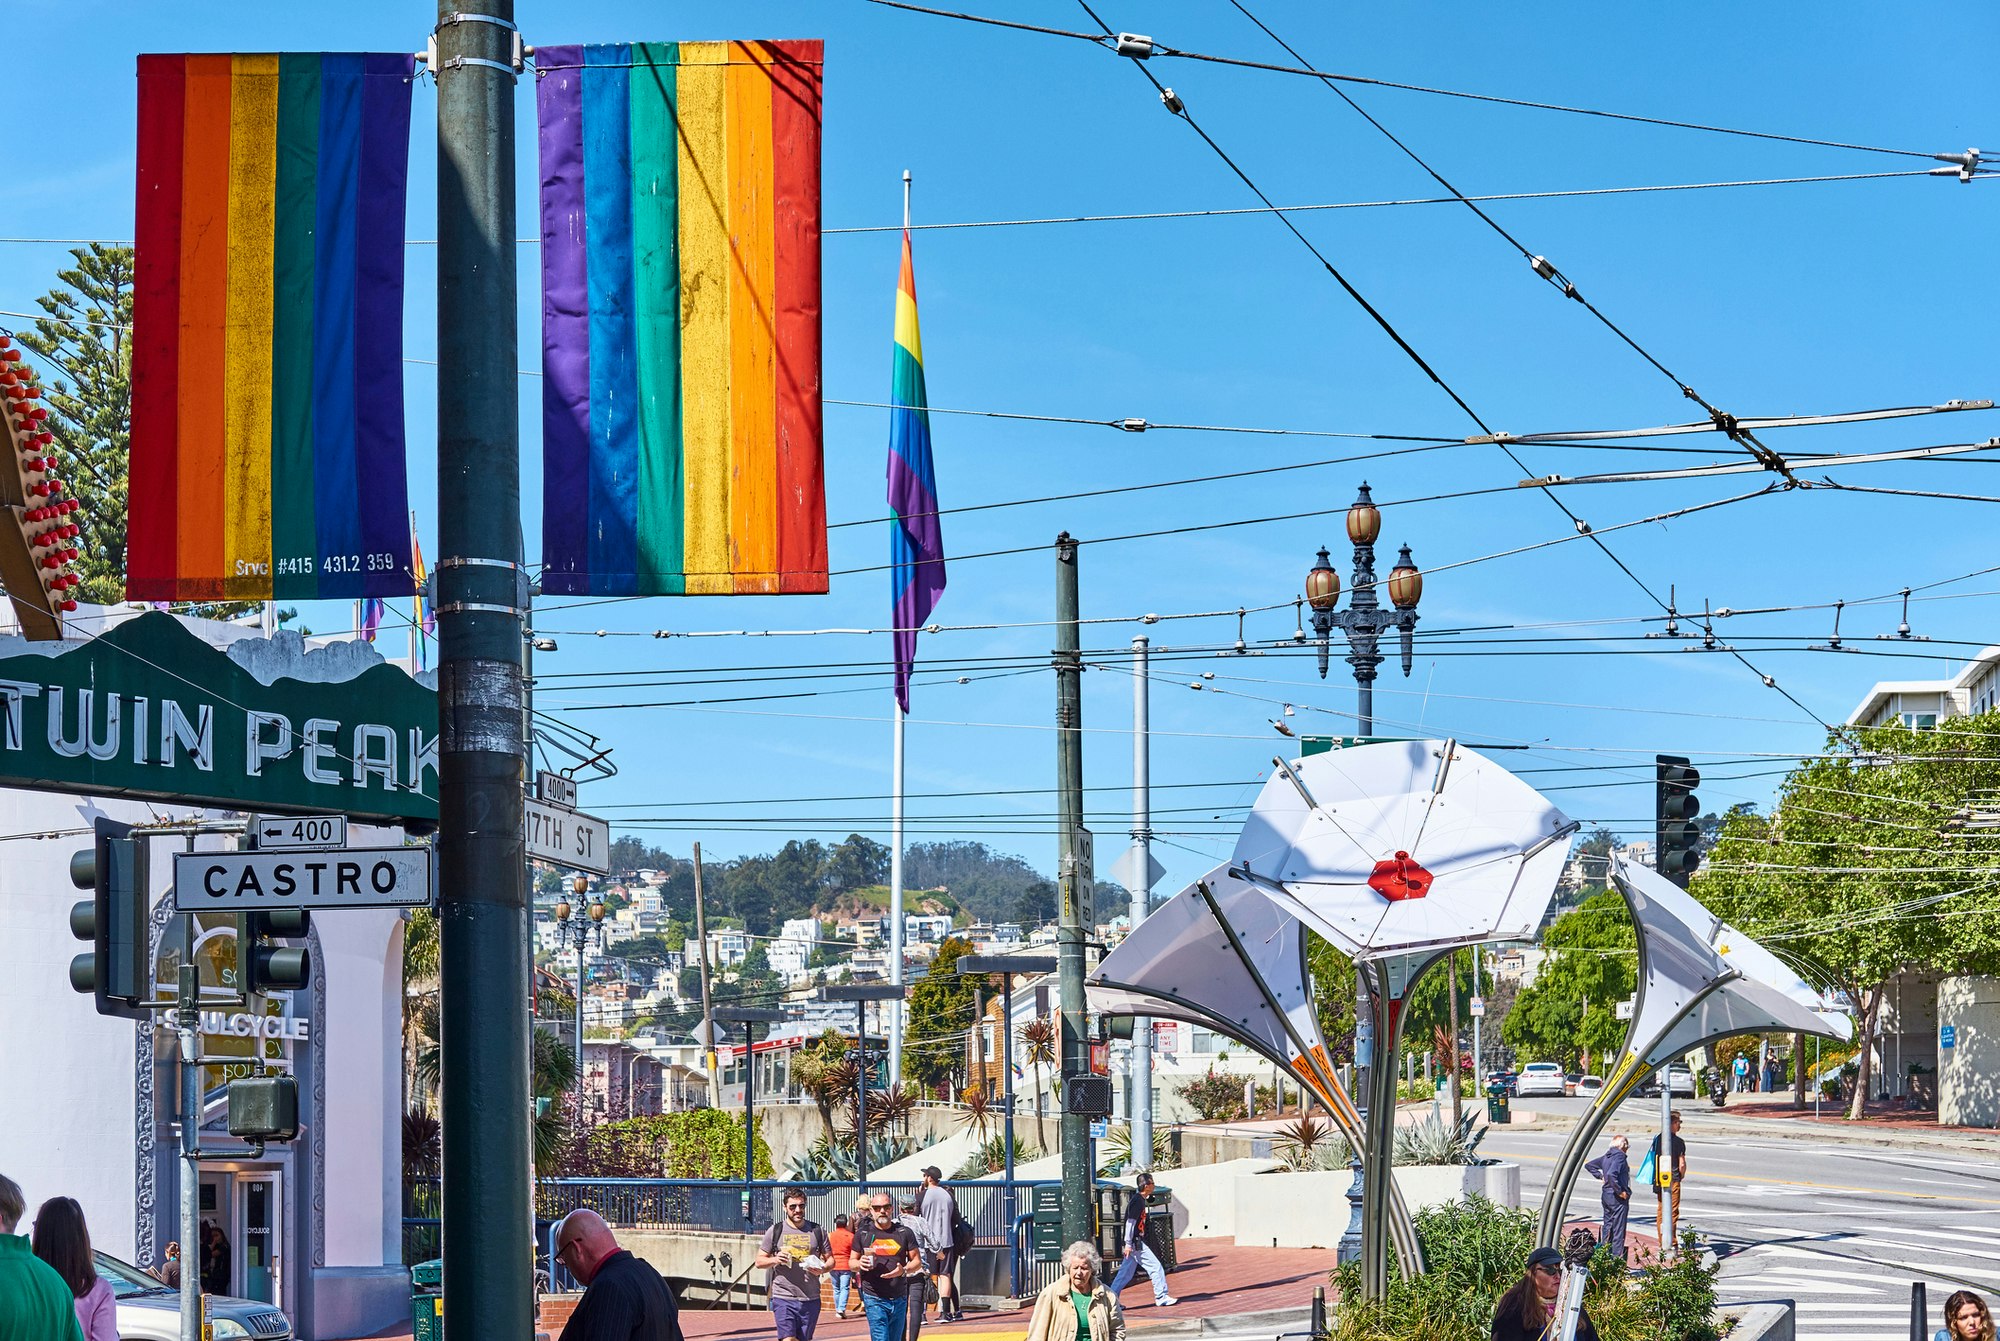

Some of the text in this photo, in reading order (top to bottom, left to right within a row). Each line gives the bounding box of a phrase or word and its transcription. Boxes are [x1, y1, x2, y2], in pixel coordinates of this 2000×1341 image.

[235, 553, 394, 576] Srvc #415 431.2 359
[0, 678, 213, 772] TWIN
[547, 777, 566, 802] 4000
[291, 820, 333, 842] 400
[526, 810, 594, 858] 17TH ST
[1079, 837, 1091, 860] NO
[203, 861, 397, 897] CASTRO
[1080, 862, 1092, 881] TURN
[163, 1008, 309, 1041] SULCYCLE
